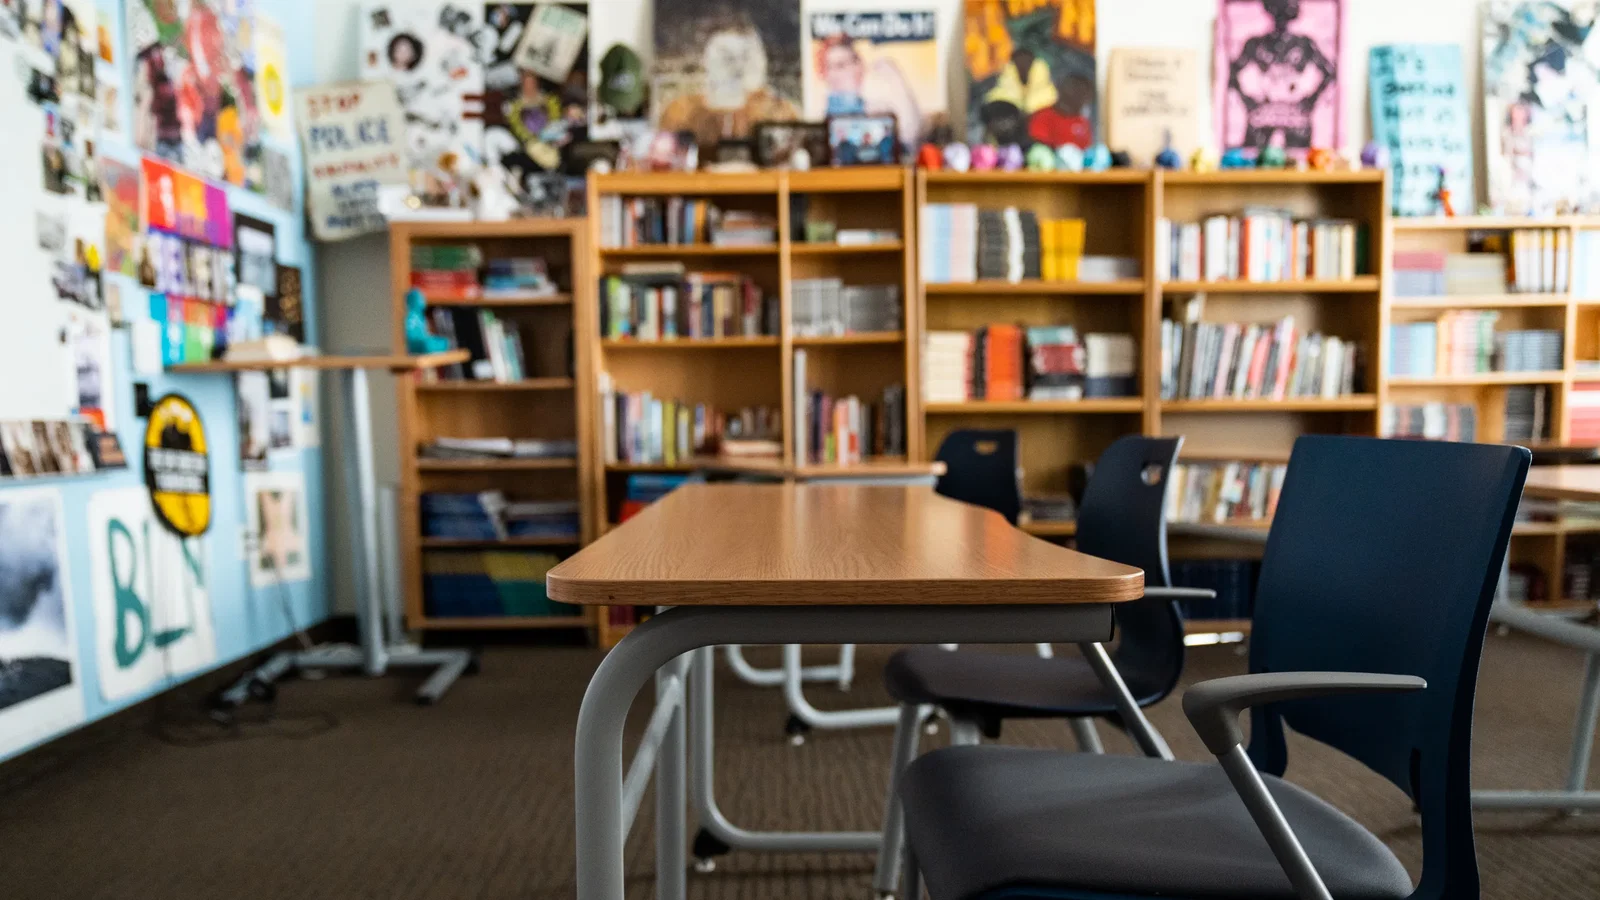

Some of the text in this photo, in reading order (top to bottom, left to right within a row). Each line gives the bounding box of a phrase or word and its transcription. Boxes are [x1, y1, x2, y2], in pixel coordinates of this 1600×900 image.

[844, 14, 881, 37] Can
[883, 14, 910, 37] Do
[307, 92, 361, 118] STOP
[308, 116, 392, 153] POLICE
